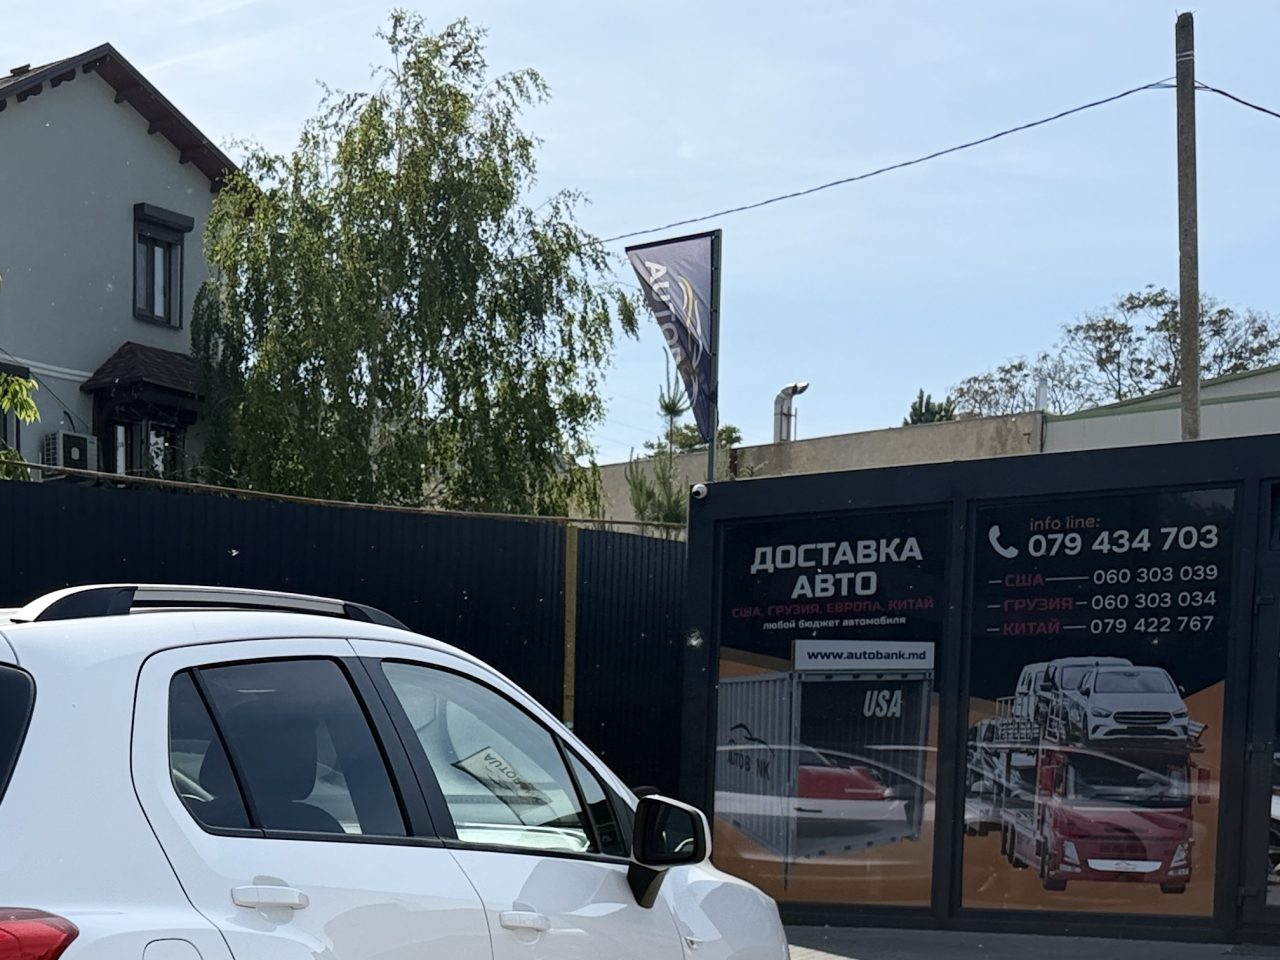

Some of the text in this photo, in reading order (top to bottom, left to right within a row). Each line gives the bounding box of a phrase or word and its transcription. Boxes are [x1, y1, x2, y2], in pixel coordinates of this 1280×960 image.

[1029, 515, 1101, 531] info line:
[1028, 525, 1219, 557] 079 434 703
[750, 536, 924, 575] ДОСТАВКА
[1004, 573, 1045, 588] США
[1092, 565, 1219, 585] 060 303 039
[790, 570, 877, 599] АВТО
[888, 596, 935, 611] КИТАЙ
[1003, 597, 1073, 612] ГРУЗИЯ
[1091, 590, 1217, 611] 060 303 034
[762, 616, 907, 631] любой бюджет автомобиля
[1002, 618, 1061, 636] КИТАЙ
[1090, 615, 1214, 634] 079 422 767
[806, 649, 927, 661] www.autobank.md
[863, 689, 903, 718] USA
